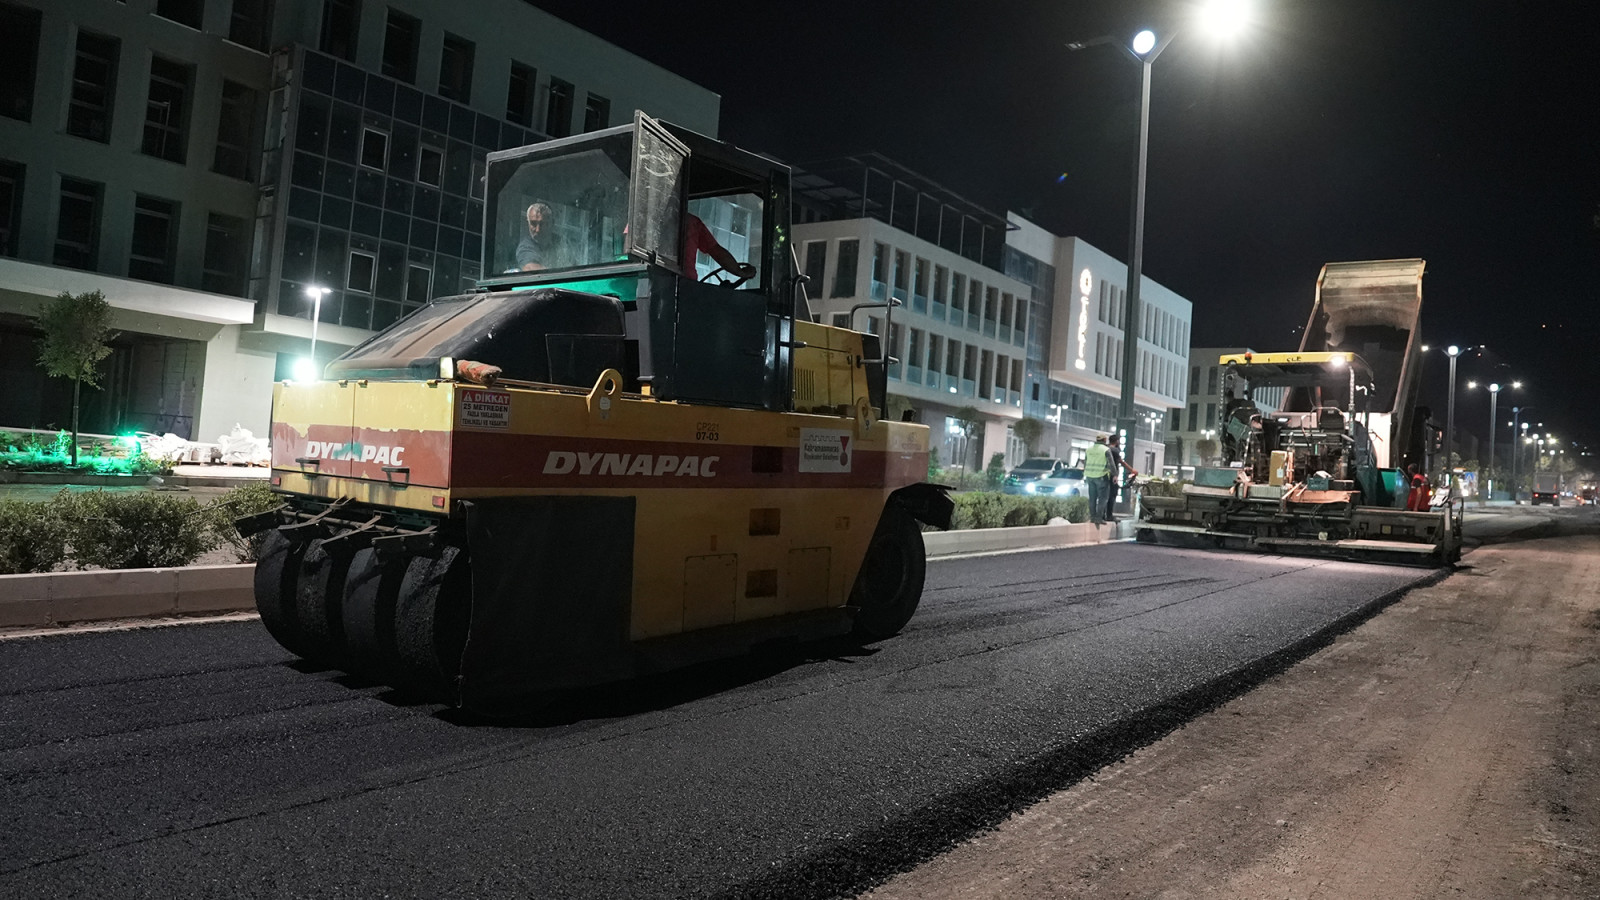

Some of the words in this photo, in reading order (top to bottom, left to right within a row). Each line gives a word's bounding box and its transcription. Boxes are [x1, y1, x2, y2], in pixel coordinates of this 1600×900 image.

[475, 392, 509, 404] DİKKAT
[473, 404, 508, 412] METREDEN
[696, 431, 719, 441] 07-03
[542, 451, 720, 477] DYNAPAC
